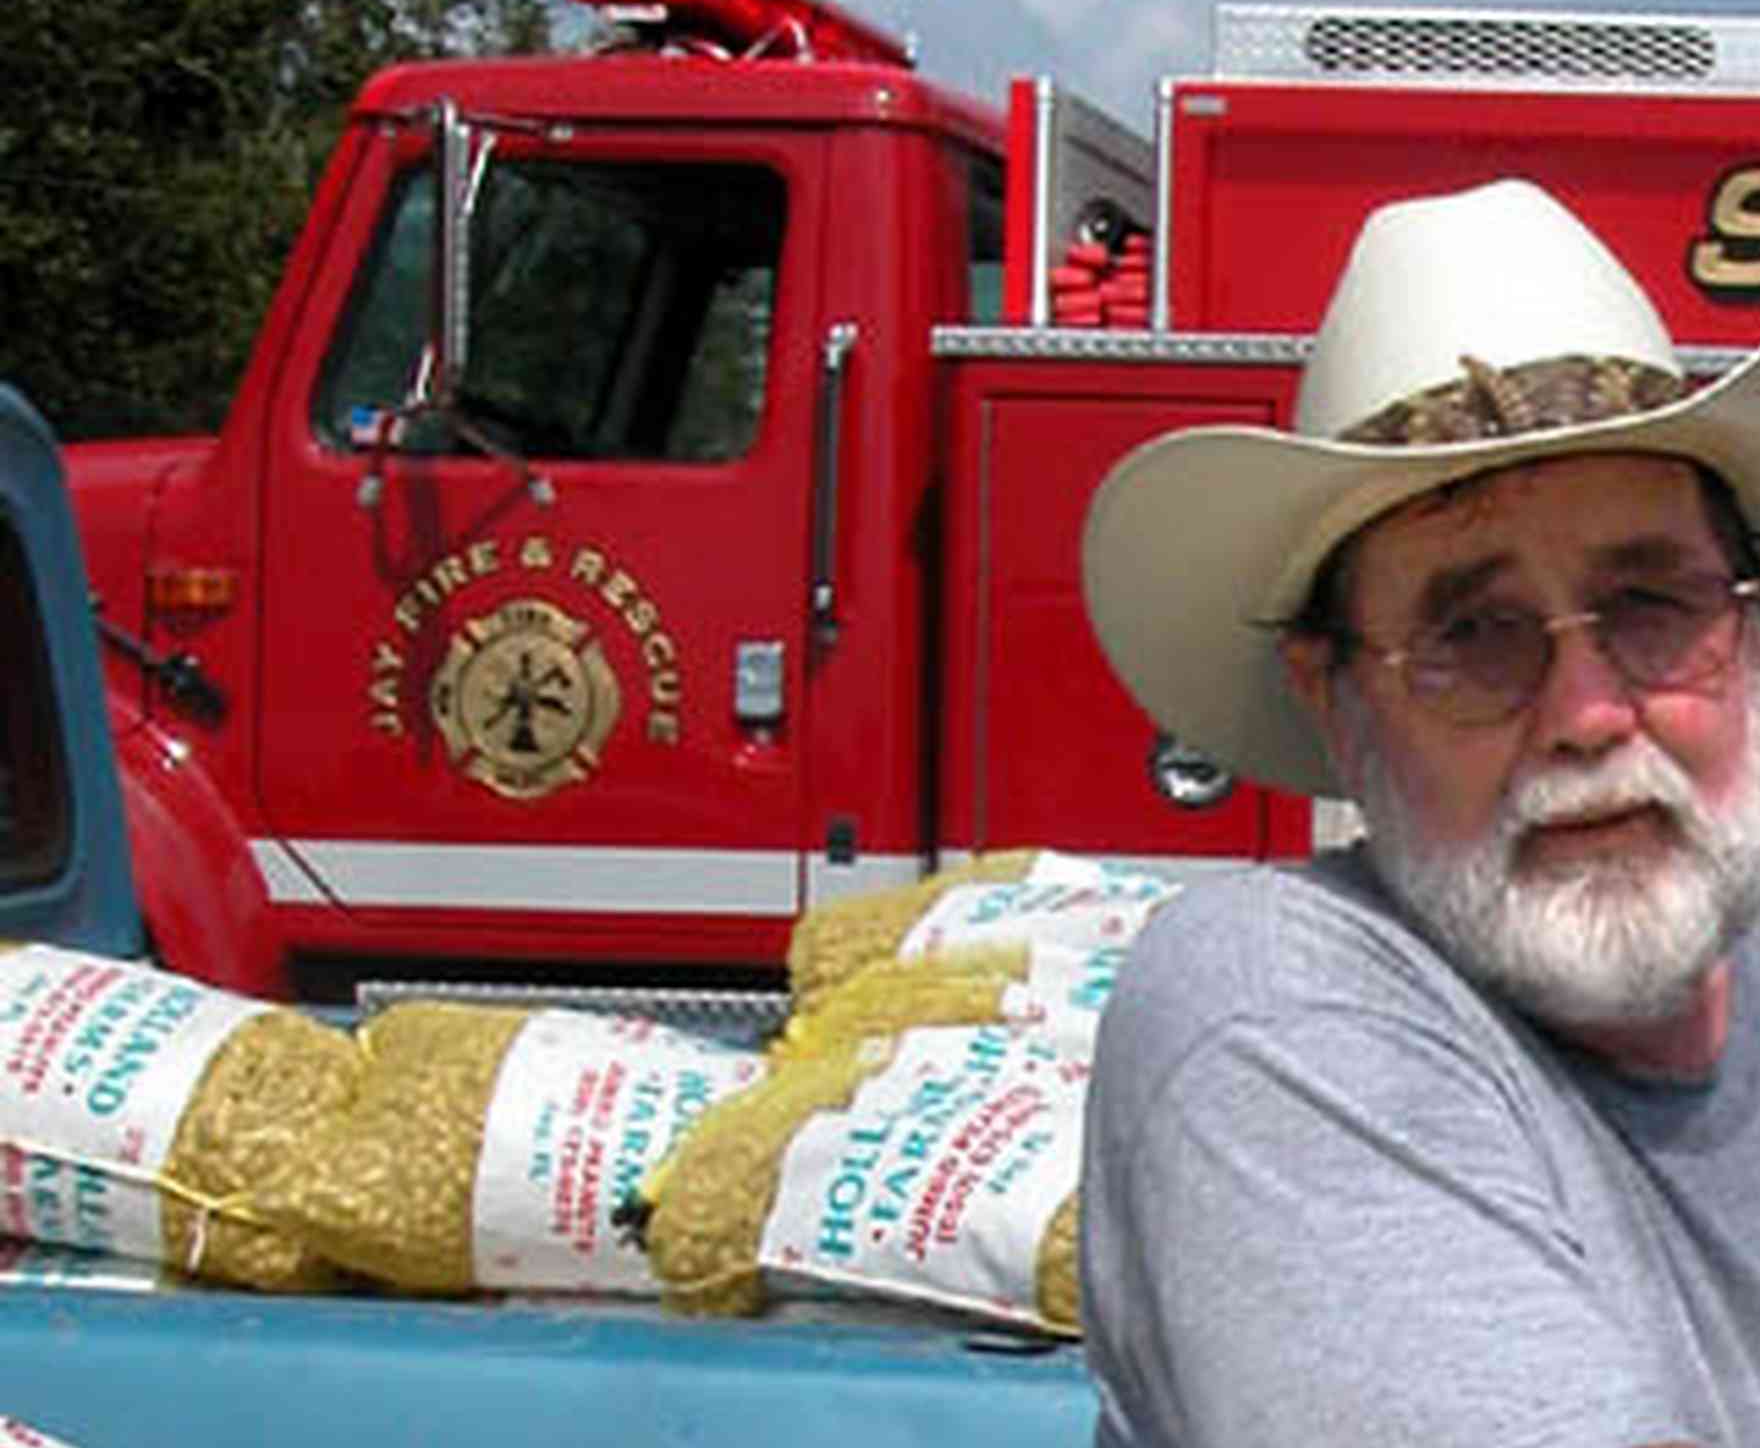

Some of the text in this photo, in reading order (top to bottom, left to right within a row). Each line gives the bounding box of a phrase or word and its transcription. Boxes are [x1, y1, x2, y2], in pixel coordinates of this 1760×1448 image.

[370, 537, 681, 744] JAY FIRE & RESCUE
